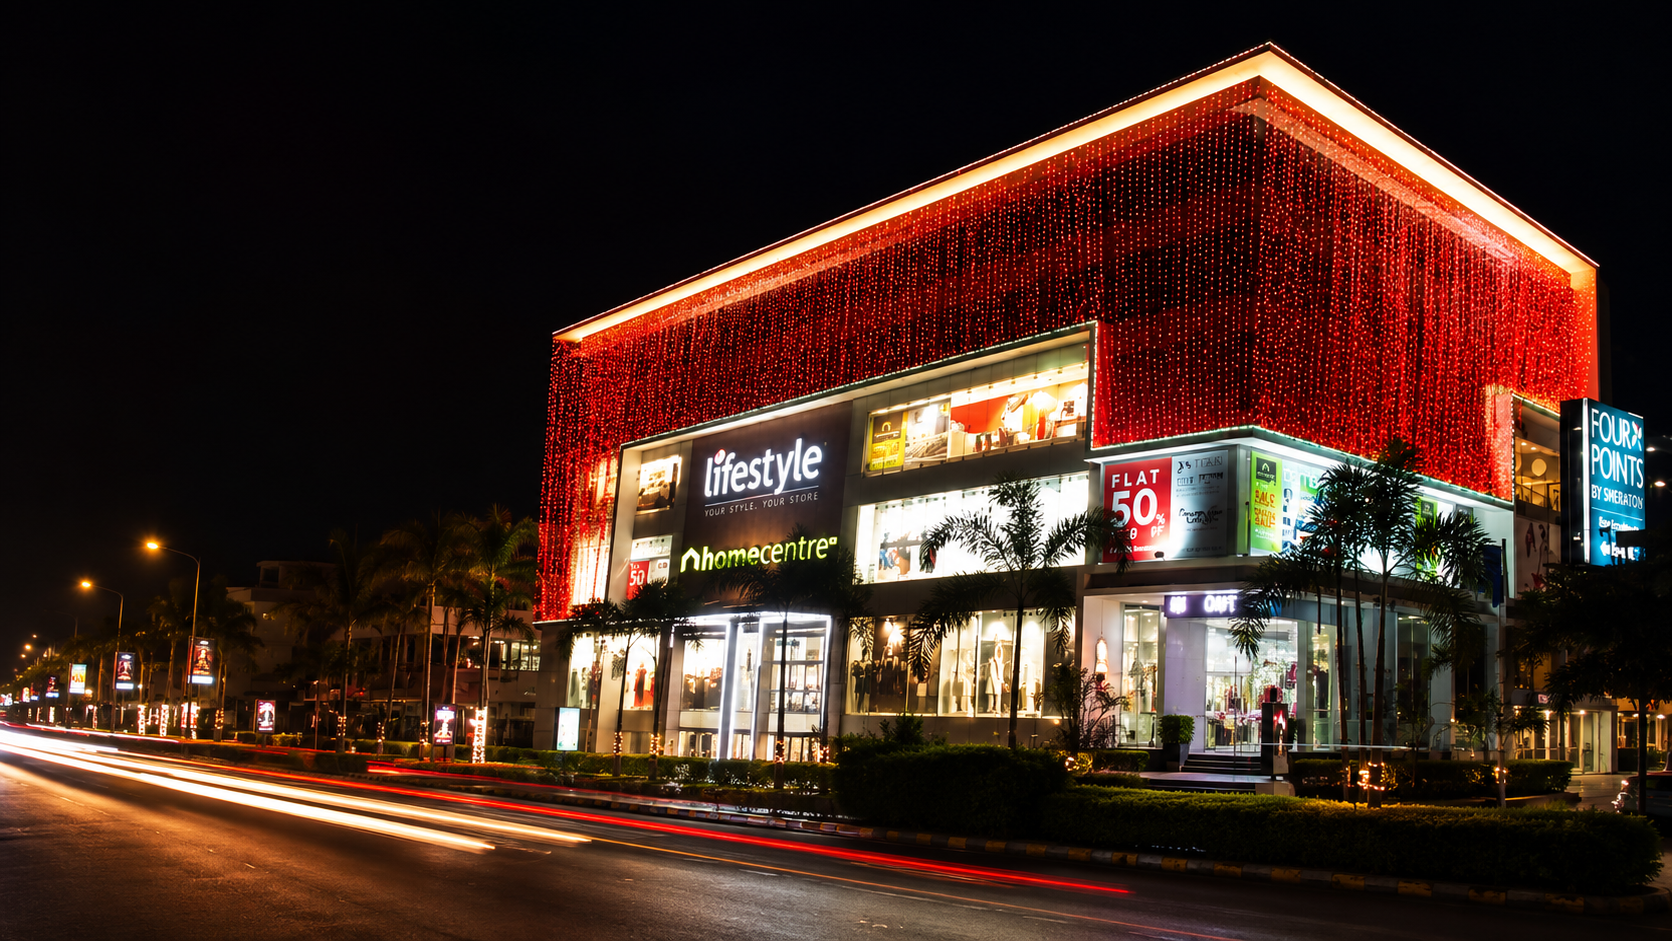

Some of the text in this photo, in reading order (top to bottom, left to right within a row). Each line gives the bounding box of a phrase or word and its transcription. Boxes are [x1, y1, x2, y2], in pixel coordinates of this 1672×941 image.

[1591, 408, 1632, 450] FOUR
[704, 437, 823, 498] lifestyle
[1111, 468, 1160, 489] FLAT
[1591, 443, 1644, 489] POINTS
[704, 491, 819, 517] YOUR STYLE. YOUR STORE
[1591, 484, 1644, 510] BY SHERATON
[701, 535, 829, 572] homecentre
[629, 569, 646, 587] 50
